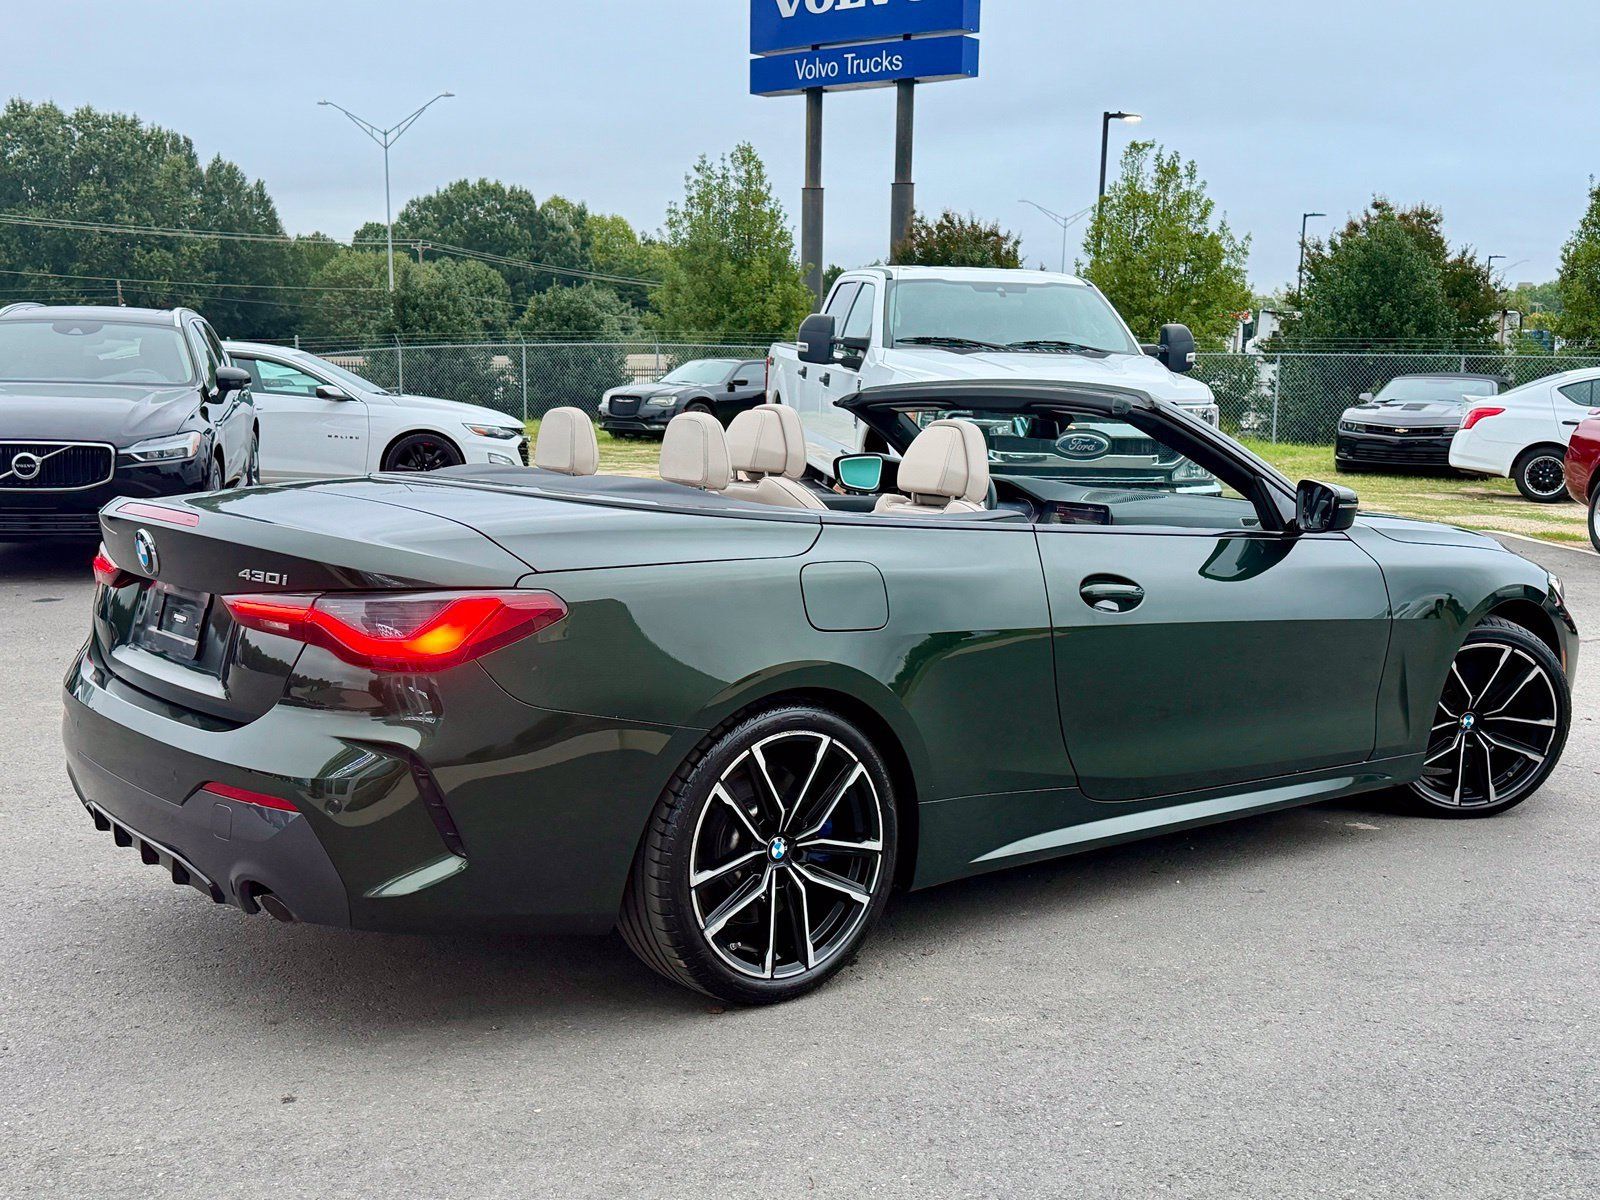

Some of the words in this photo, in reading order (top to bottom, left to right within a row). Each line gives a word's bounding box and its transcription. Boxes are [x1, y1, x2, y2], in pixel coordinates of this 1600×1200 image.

[794, 57, 839, 80] Volvo
[843, 50, 903, 75] Trucks
[1068, 437, 1097, 451] Ford
[238, 568, 288, 586] 430i
